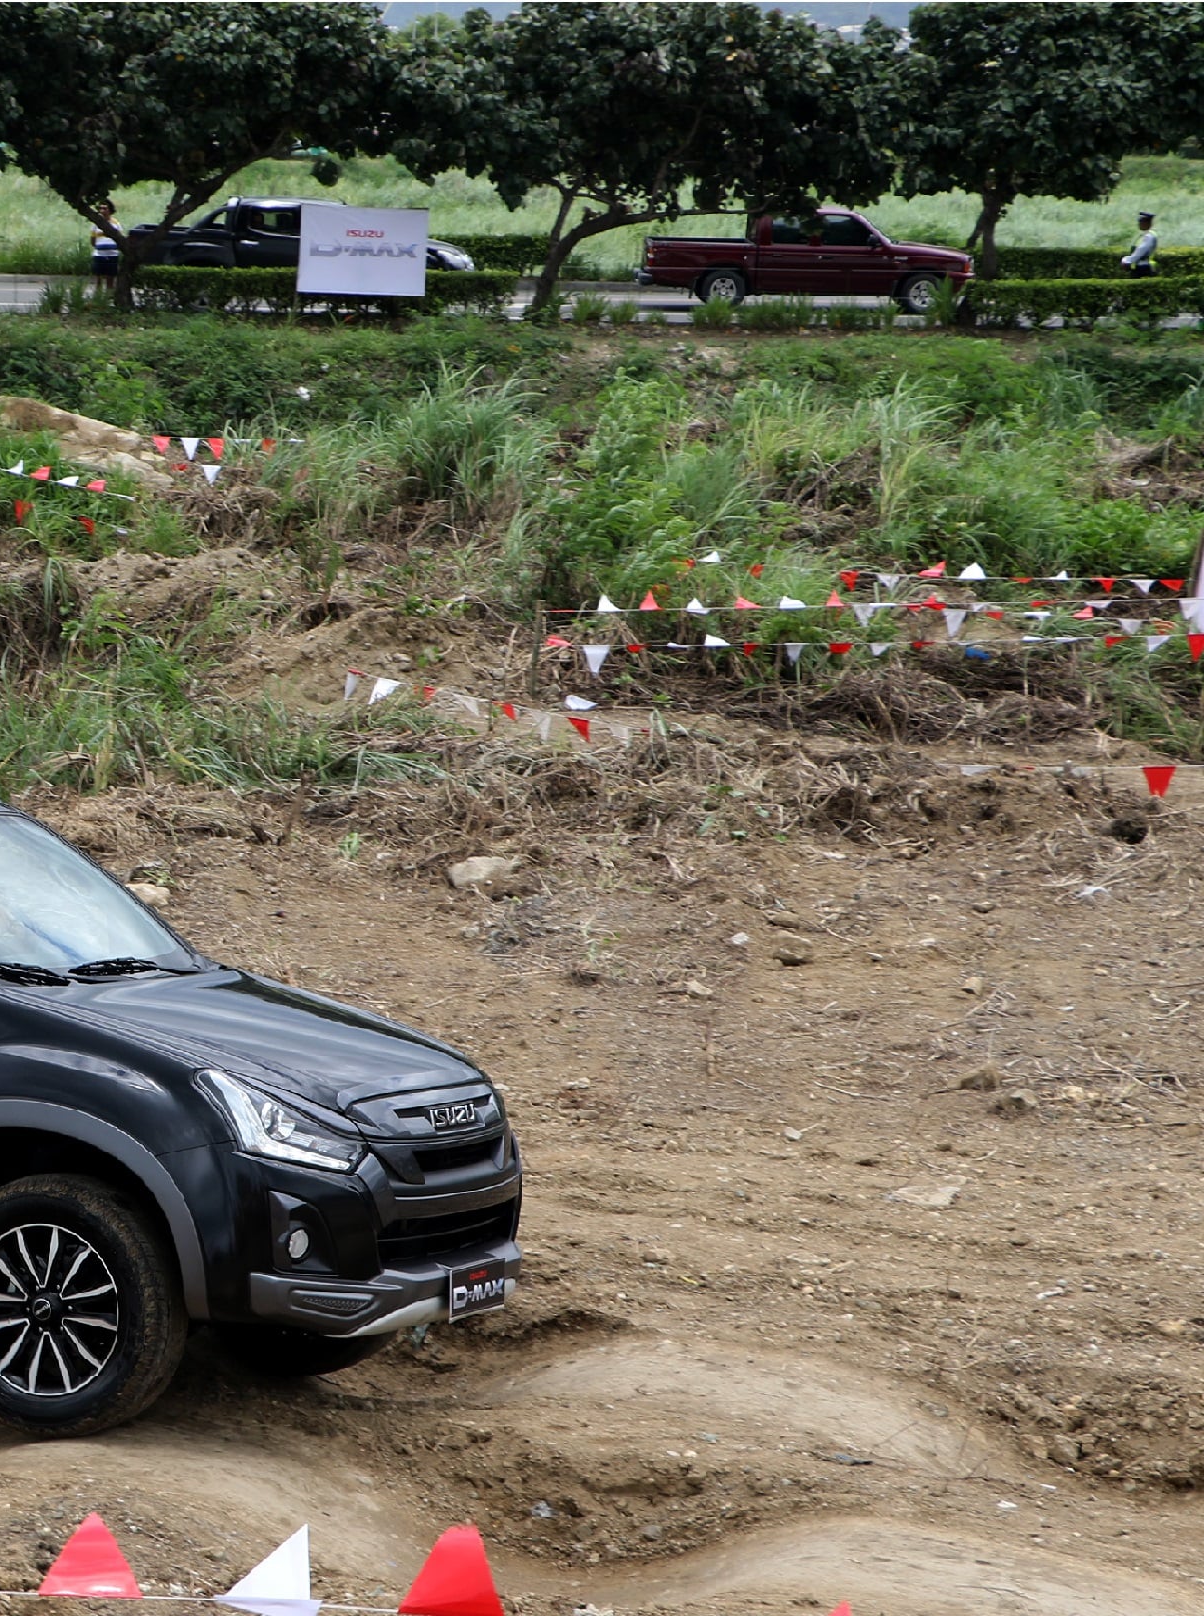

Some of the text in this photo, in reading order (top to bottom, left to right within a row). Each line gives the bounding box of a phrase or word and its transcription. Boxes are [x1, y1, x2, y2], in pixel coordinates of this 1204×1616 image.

[345, 229, 385, 238] ISUZU
[309, 241, 418, 258] D-MAX
[429, 1103, 476, 1128] ISUZU
[453, 1277, 505, 1310] D-MAX
